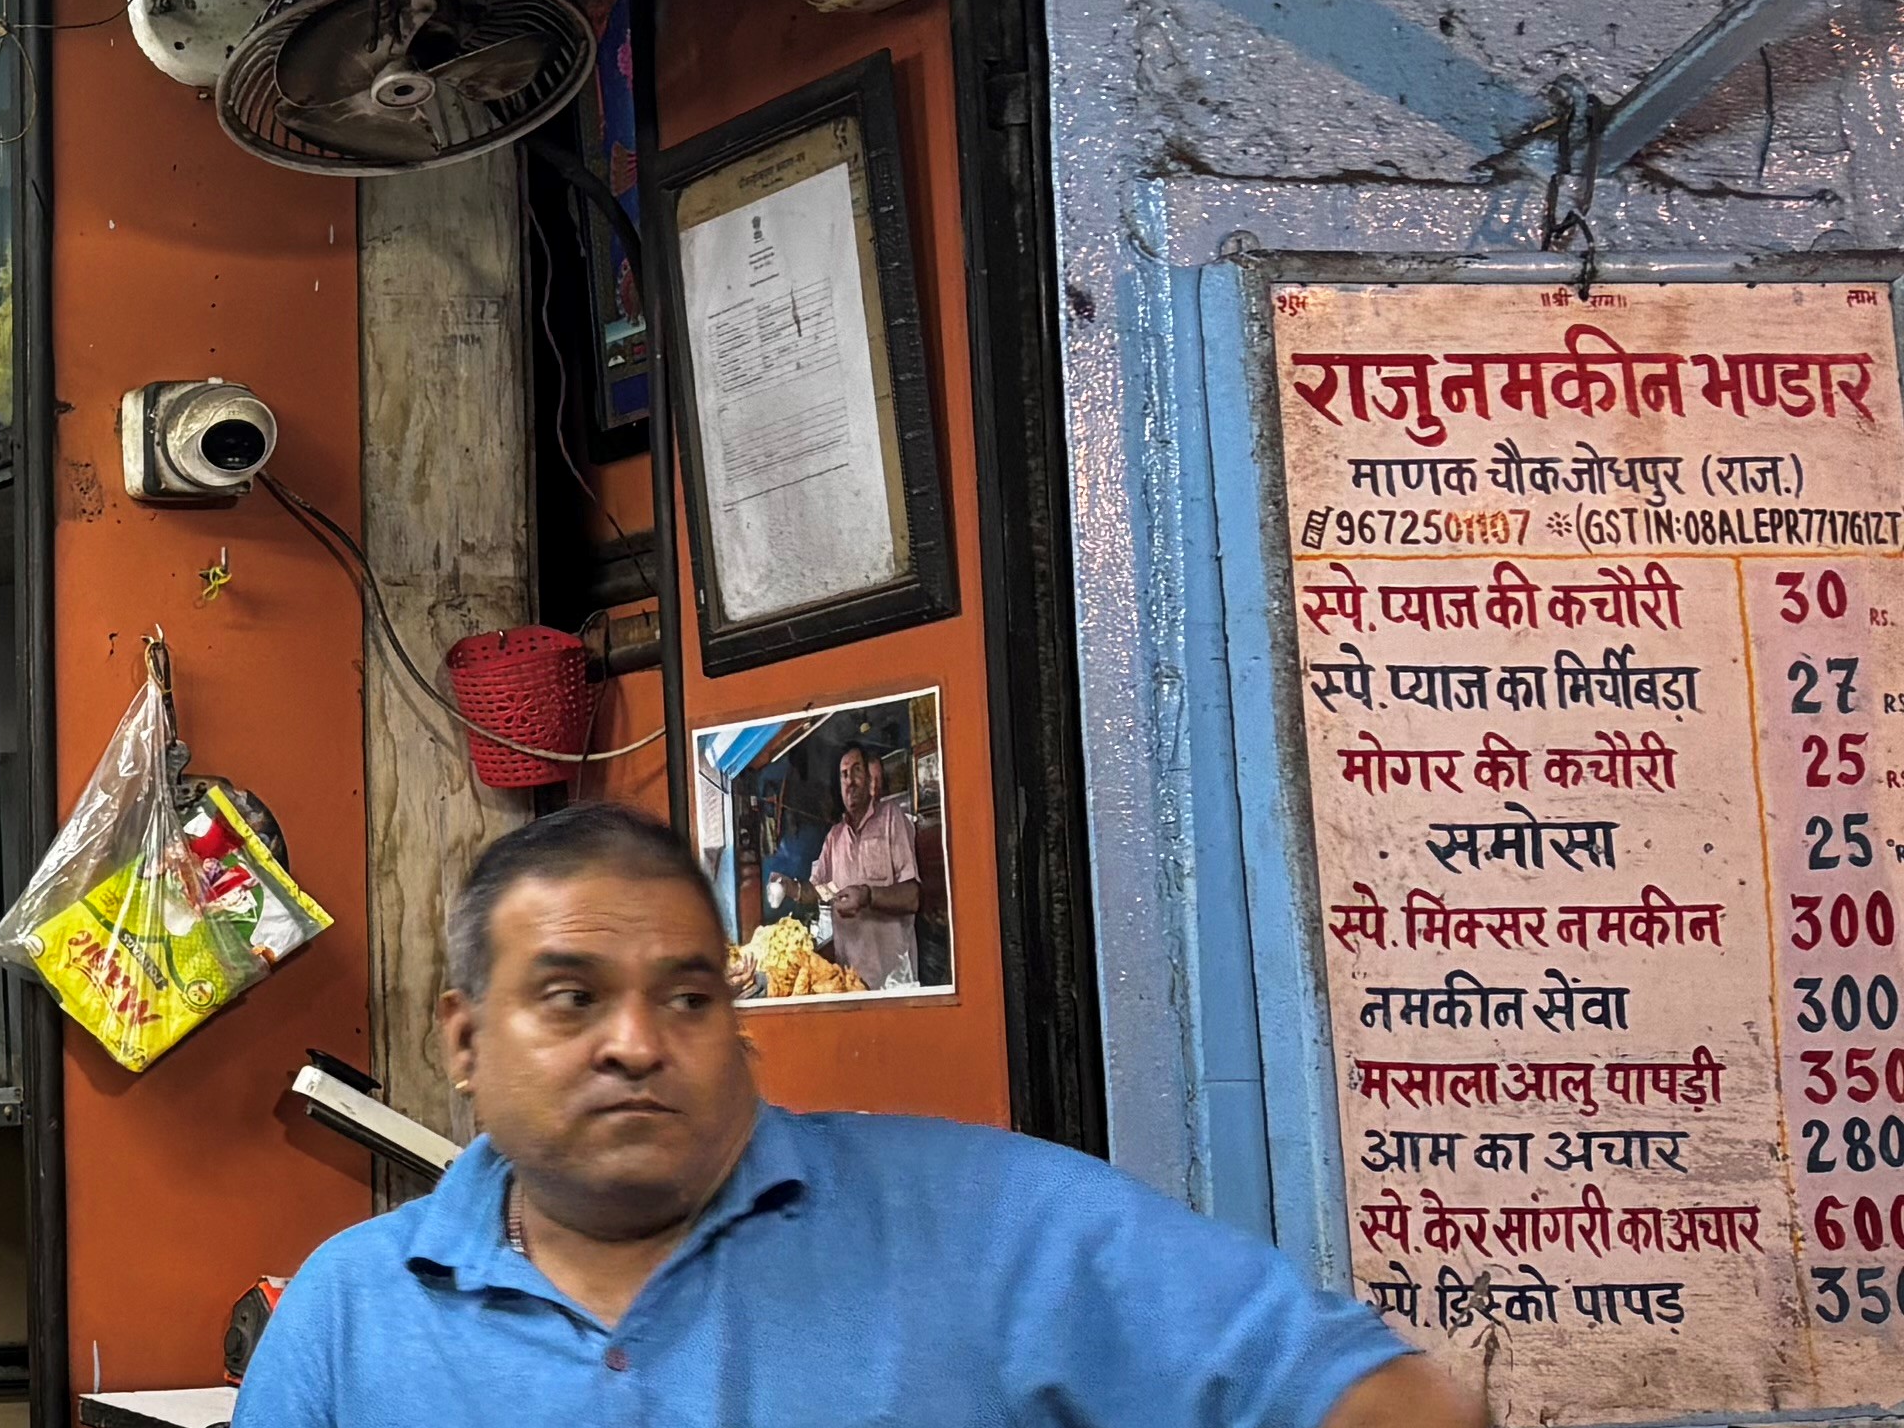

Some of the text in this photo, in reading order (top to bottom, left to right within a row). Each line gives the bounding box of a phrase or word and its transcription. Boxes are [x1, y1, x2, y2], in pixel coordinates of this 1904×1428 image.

[1847, 290, 1877, 307] लाभ
[1442, 324, 1687, 419] नमकीन
[1690, 353, 1876, 422] भण्डार
[1347, 458, 1477, 497] माणक
[1485, 437, 1563, 495] चौक
[1563, 441, 1686, 507] जोधपुर
[1378, 585, 1480, 632] प्याज
[1486, 560, 1542, 630] की
[1548, 561, 1684, 631] कचौरी
[1775, 569, 1848, 624] 30
[1385, 664, 1492, 712] प्याज
[1497, 665, 1548, 712] का
[1787, 656, 1859, 714] 27
[1337, 730, 1465, 796] मोगर
[1474, 731, 1532, 793] की
[1544, 730, 1678, 794] कचौरी
[1802, 732, 1868, 788] 25
[1426, 801, 1621, 873] समोसा
[1805, 812, 1872, 870] 25
[1401, 888, 1549, 950] मिक्सर
[1557, 884, 1726, 951] नमकीन
[1790, 890, 1894, 951] 300
[1360, 969, 1528, 1032] नमकीन
[1793, 974, 1898, 1032] 300
[1355, 1059, 1500, 1109] मसाला
[1361, 1115, 1904, 1174] आम का अचार 280
[1420, 1188, 1492, 1258] केर
[1618, 1207, 1664, 1254] का
[1666, 1206, 1765, 1254] अचार
[1811, 1266, 1904, 1324] 35
